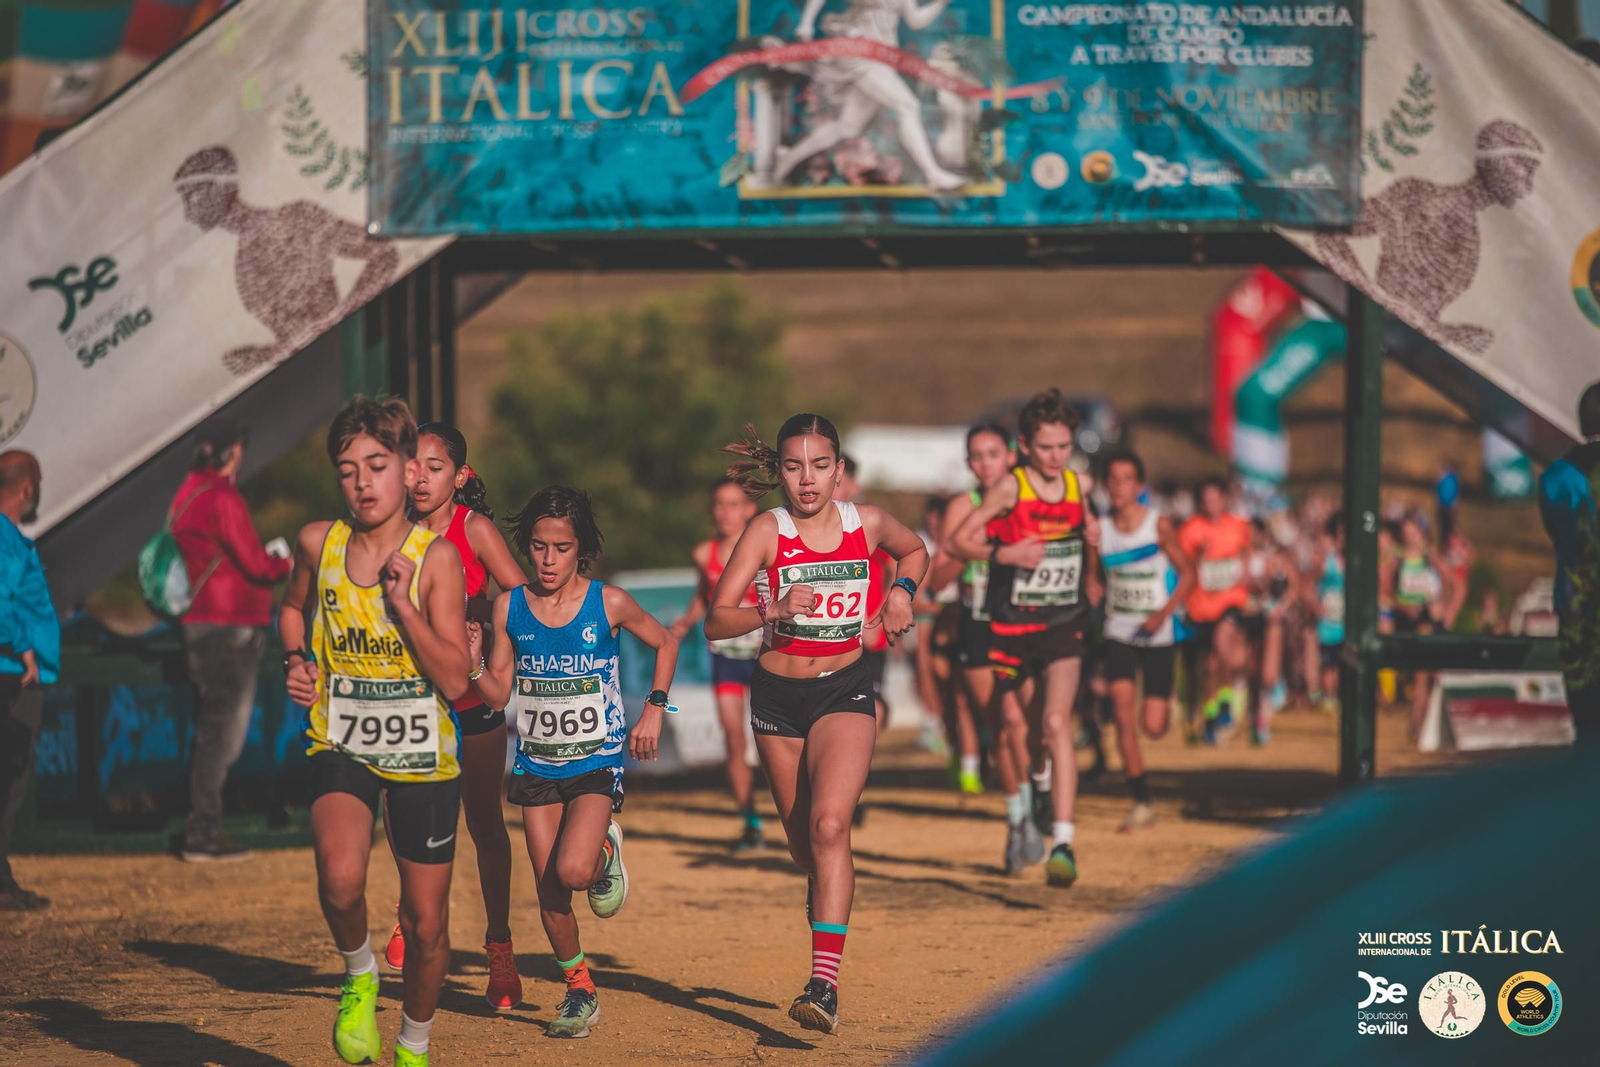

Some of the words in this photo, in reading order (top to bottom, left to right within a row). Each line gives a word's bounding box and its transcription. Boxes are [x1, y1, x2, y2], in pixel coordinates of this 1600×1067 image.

[528, 7, 646, 38] CROSS
[1017, 5, 1178, 26] CAMPEONATO
[1180, 5, 1211, 25] DE
[1127, 26, 1157, 43] DE
[1158, 25, 1245, 46] CAMPO
[1070, 46, 1090, 65] A
[1180, 45, 1226, 65] POR
[1227, 46, 1314, 67] CLUBES
[1082, 86, 1103, 111] 9
[1154, 87, 1338, 115] NOVIEMBRE
[76, 306, 154, 369] Sevilla
[806, 563, 850, 577] ITÁLICA
[517, 632, 535, 641] vive
[520, 653, 595, 673] CHAPIN
[359, 680, 410, 695] ITÁLICA
[535, 680, 577, 692] ITÁLICA
[339, 713, 430, 746] 7995
[524, 706, 599, 738] 7969
